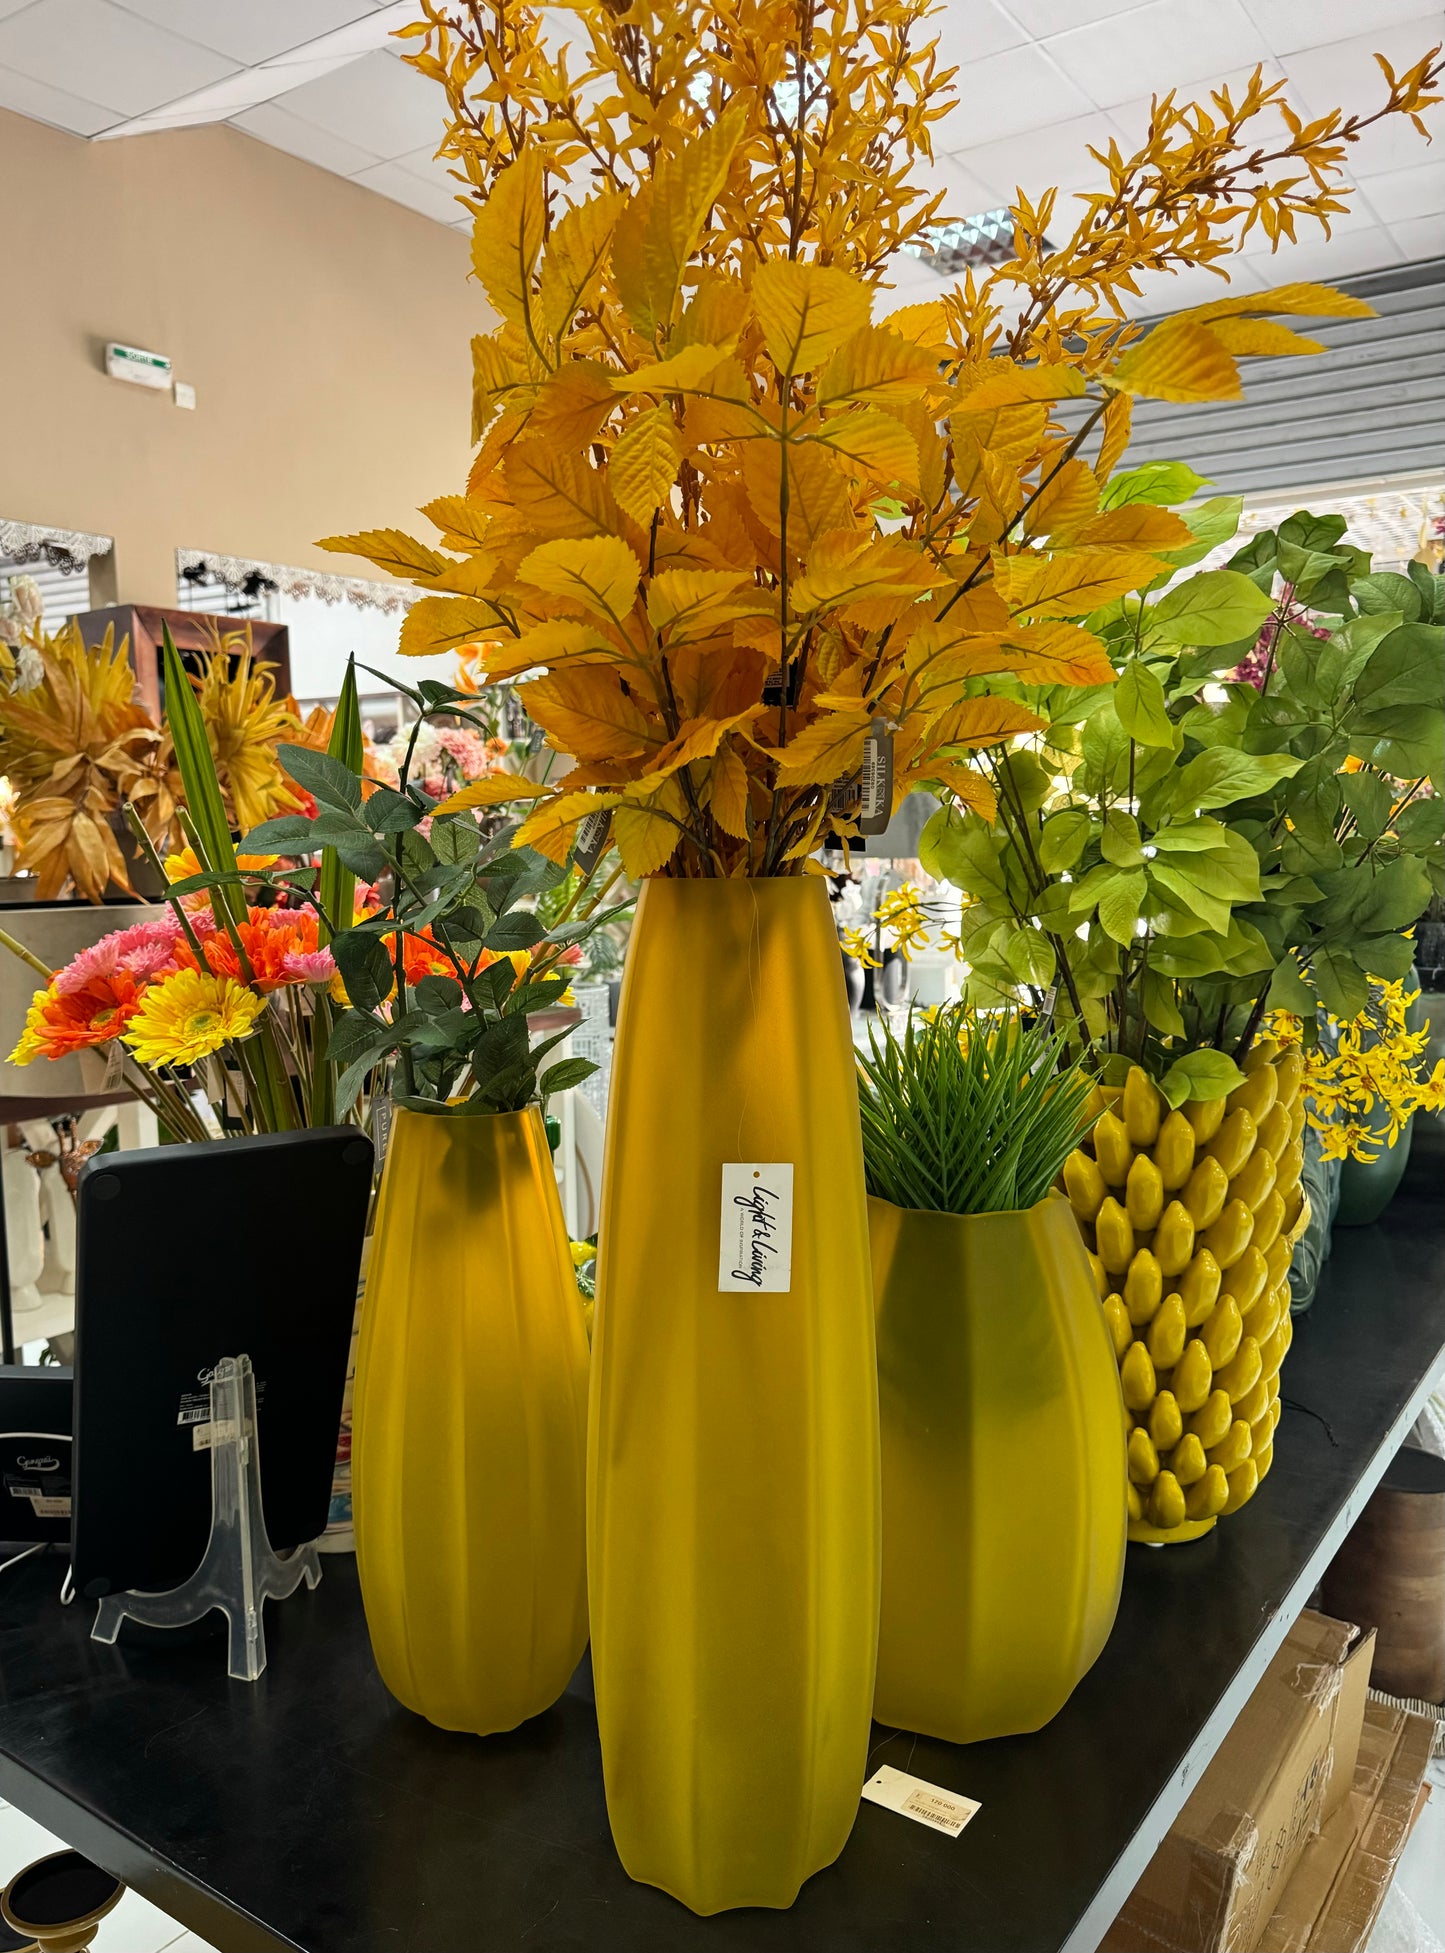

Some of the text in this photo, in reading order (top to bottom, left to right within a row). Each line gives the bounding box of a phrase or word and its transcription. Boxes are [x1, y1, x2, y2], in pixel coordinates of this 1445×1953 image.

[731, 1186, 779, 1287] Light & Living
